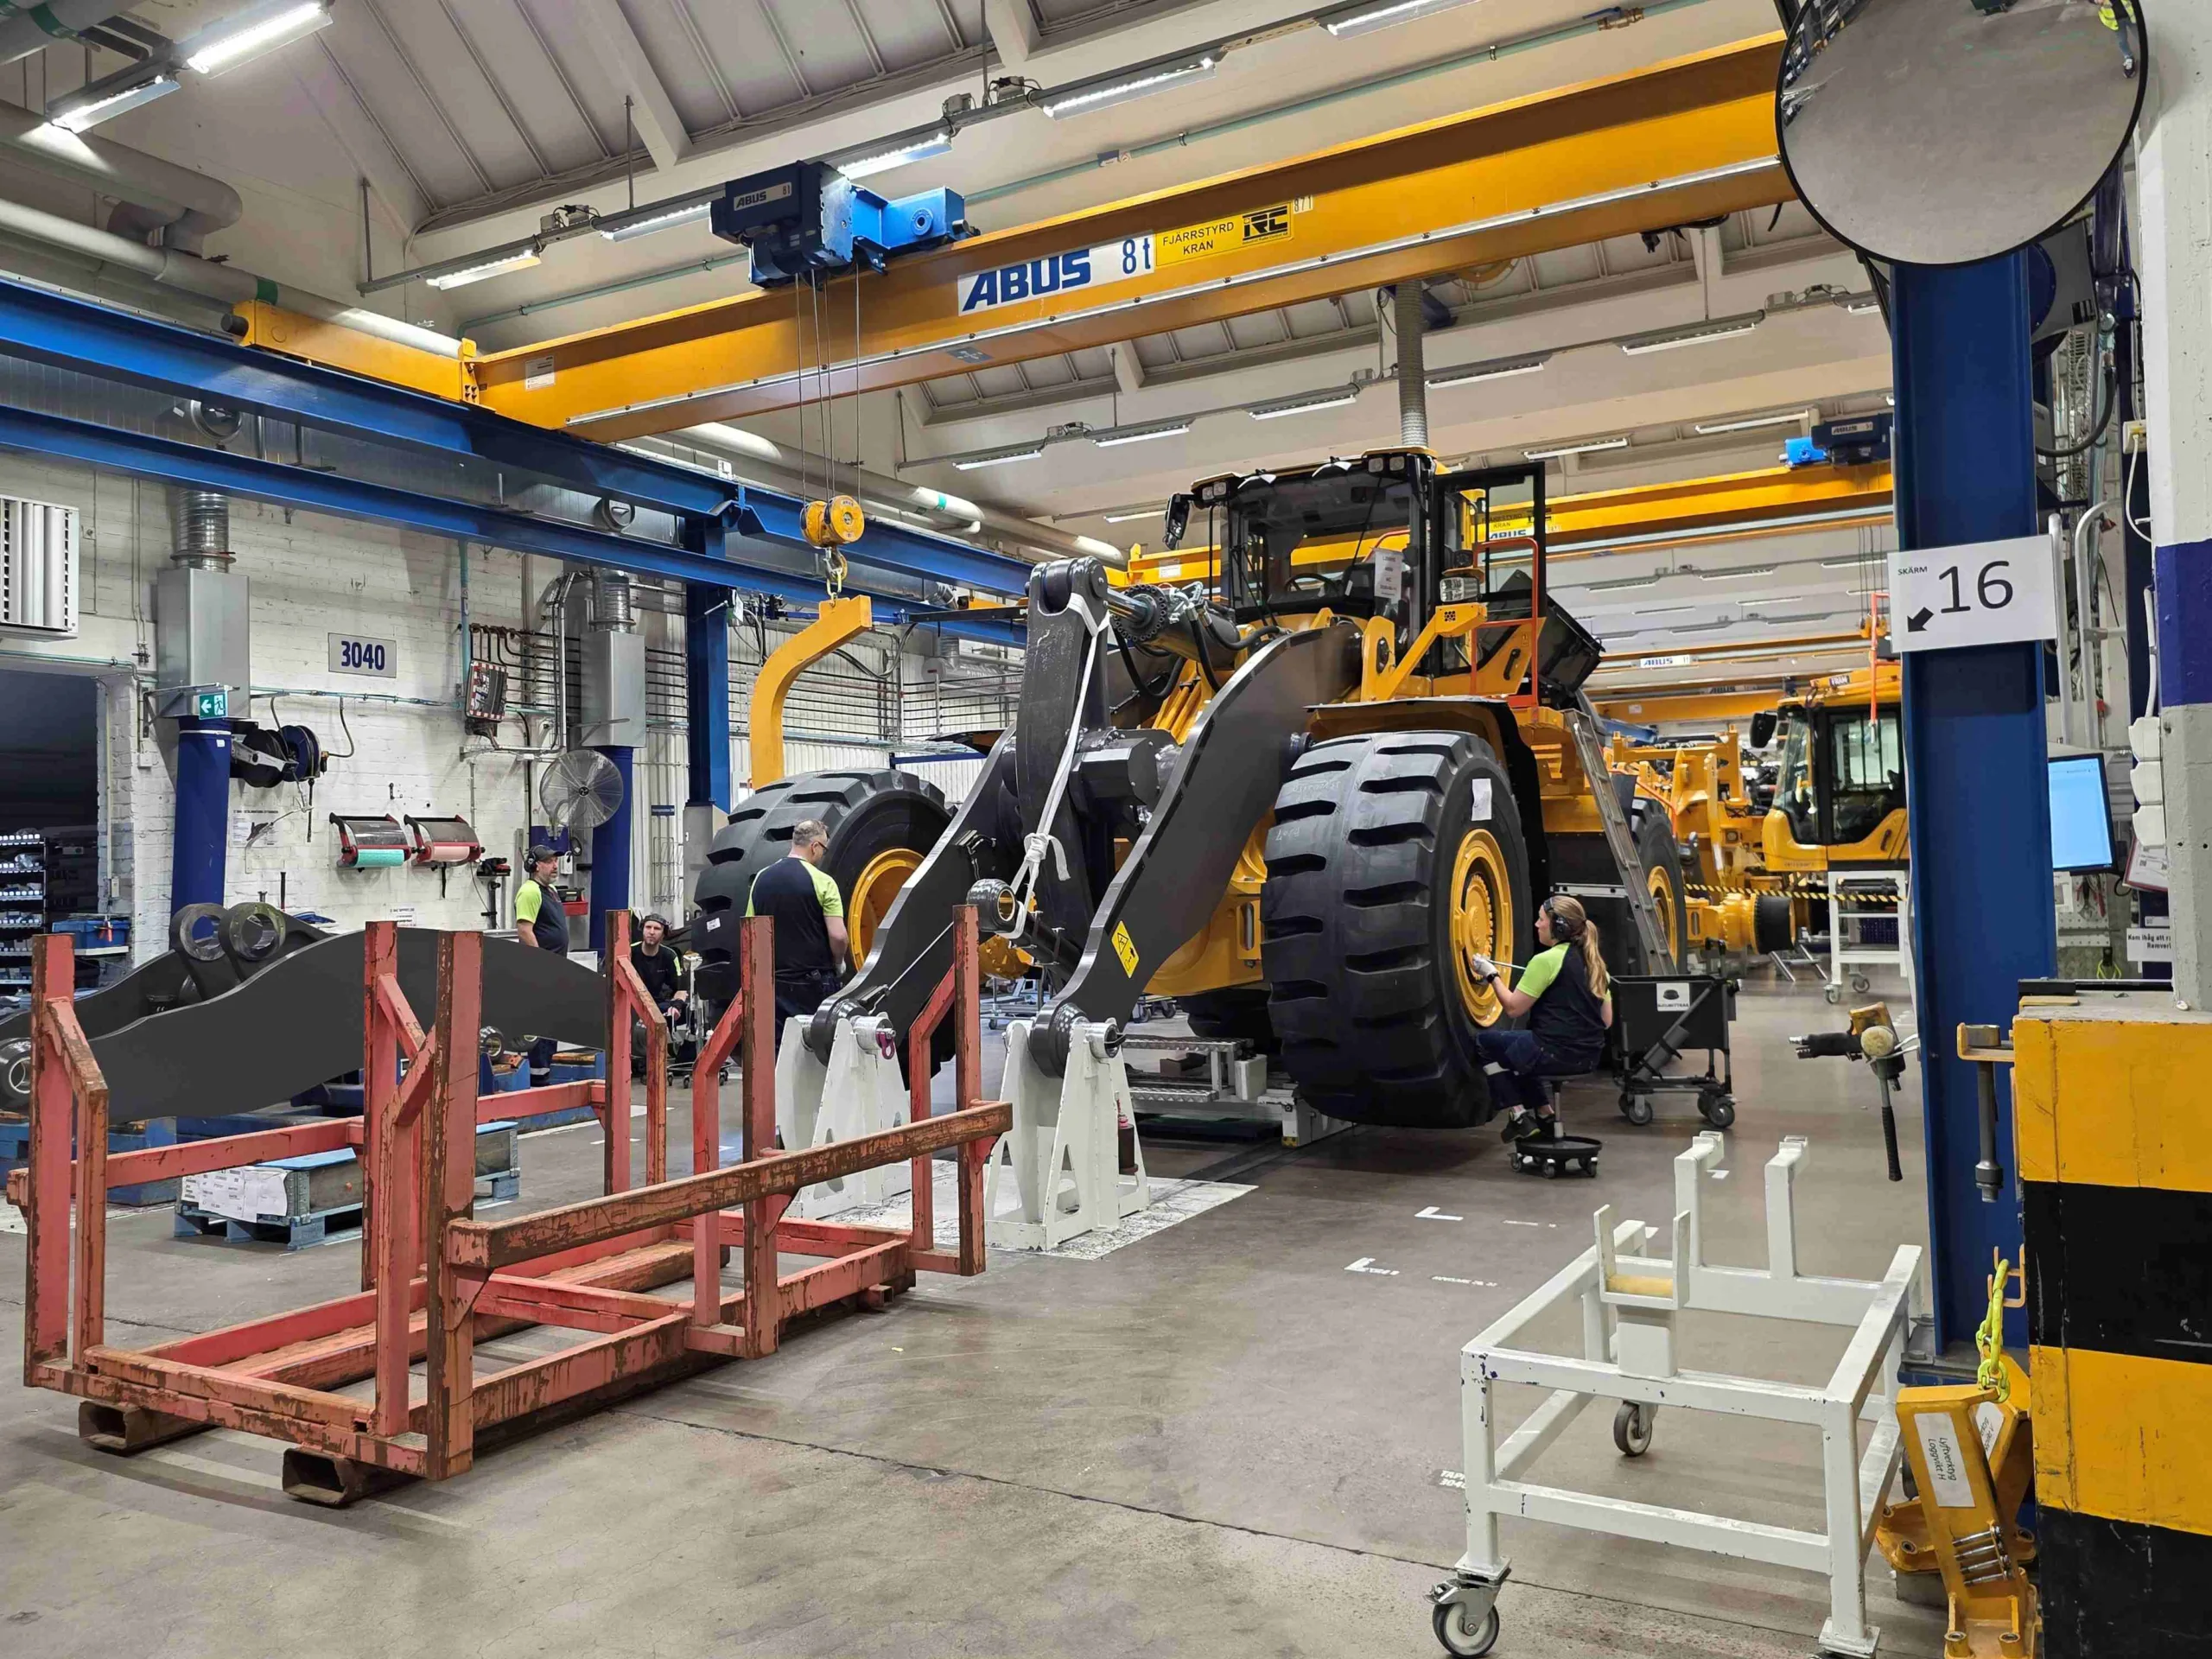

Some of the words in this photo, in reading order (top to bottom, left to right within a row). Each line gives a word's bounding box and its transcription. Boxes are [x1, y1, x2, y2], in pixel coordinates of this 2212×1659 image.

[736, 191, 767, 208] ABUS
[1163, 221, 1235, 245] FJÄRRSTYRD
[1183, 240, 1214, 255] KRAN
[962, 249, 1091, 312] ABUS
[1897, 566, 1928, 575] SKÄRM
[1938, 560, 2013, 613] 16
[340, 640, 385, 671] 3040
[1643, 658, 1673, 666] ABUS
[2142, 933, 2155, 943] ihåg
[1939, 1437, 1957, 1481] Lyftverktyg
[1937, 1472, 1947, 1481] H
